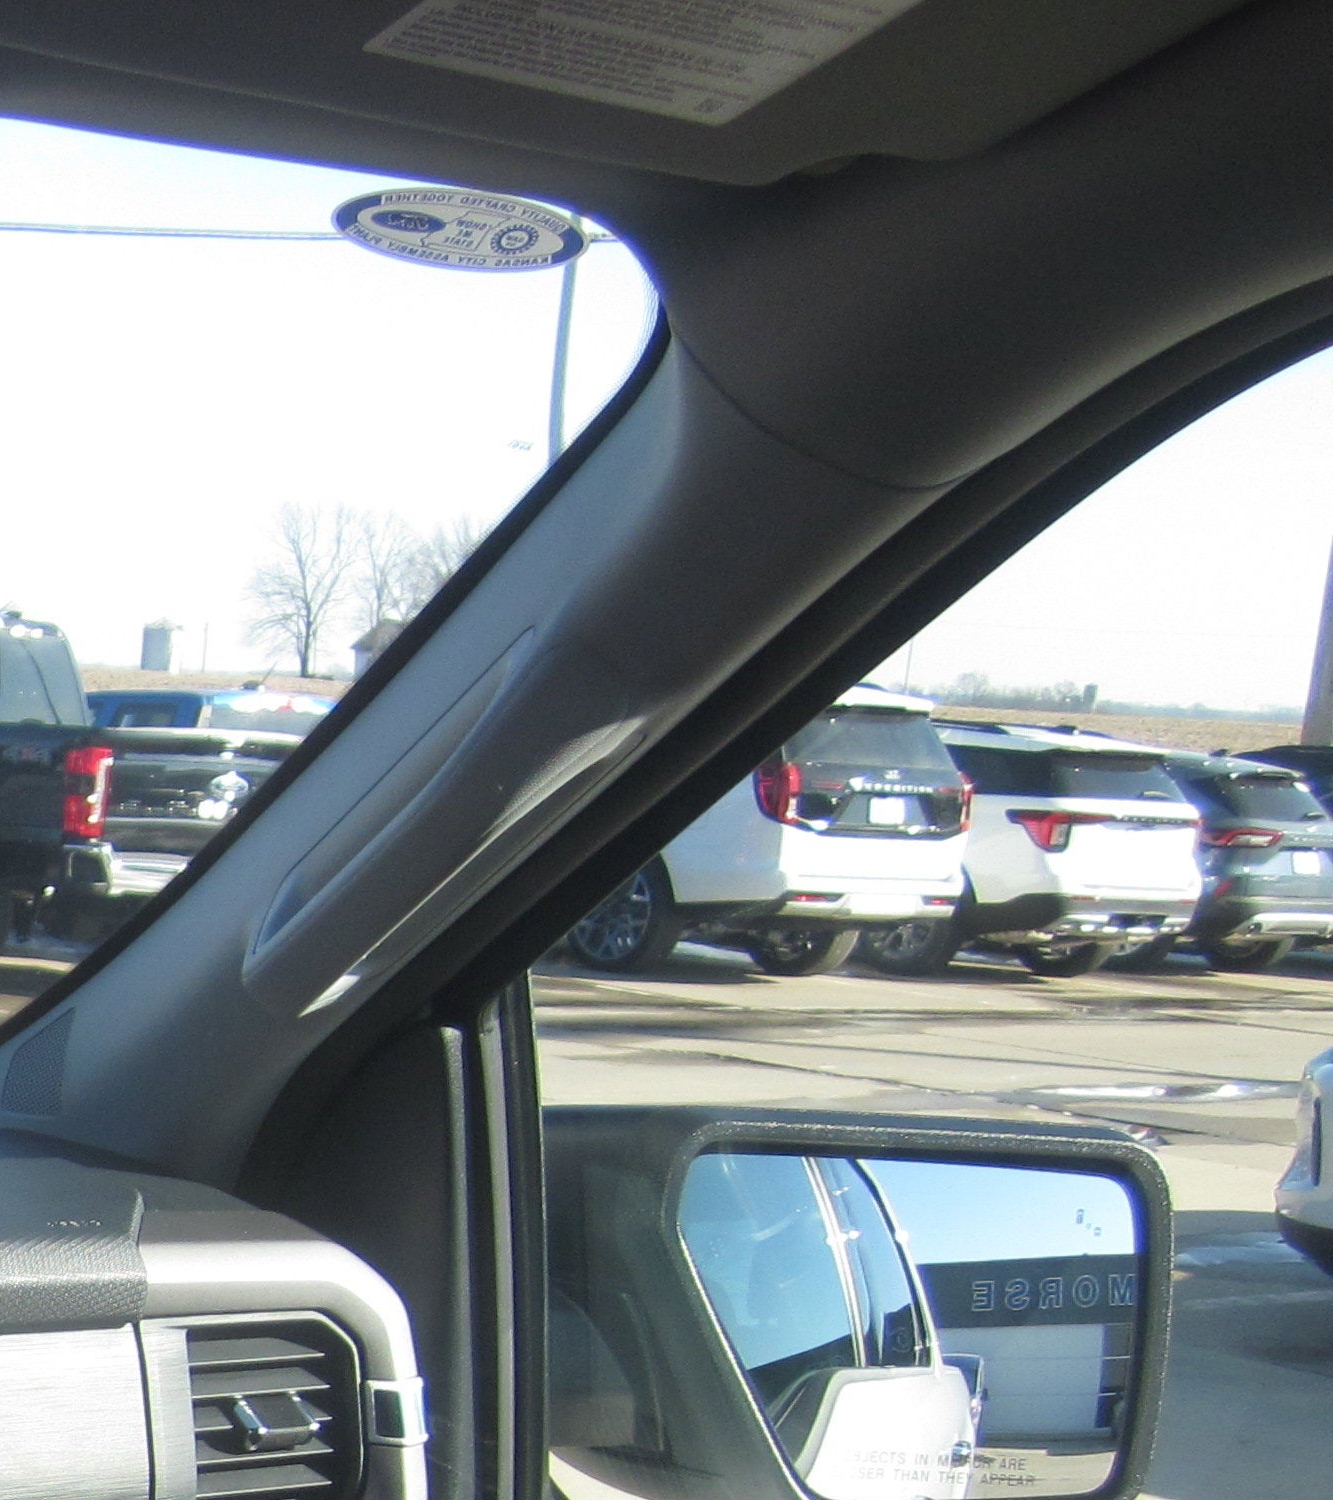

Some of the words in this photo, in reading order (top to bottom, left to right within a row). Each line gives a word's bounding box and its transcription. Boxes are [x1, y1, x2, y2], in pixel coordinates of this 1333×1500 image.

[845, 1450, 906, 1466] BJECTS
[914, 1453, 929, 1466] IN
[937, 1454, 992, 1469] MIOR
[998, 1457, 1027, 1472] ARE
[893, 1468, 930, 1483] THAN
[980, 1473, 1036, 1488] APPEAR
